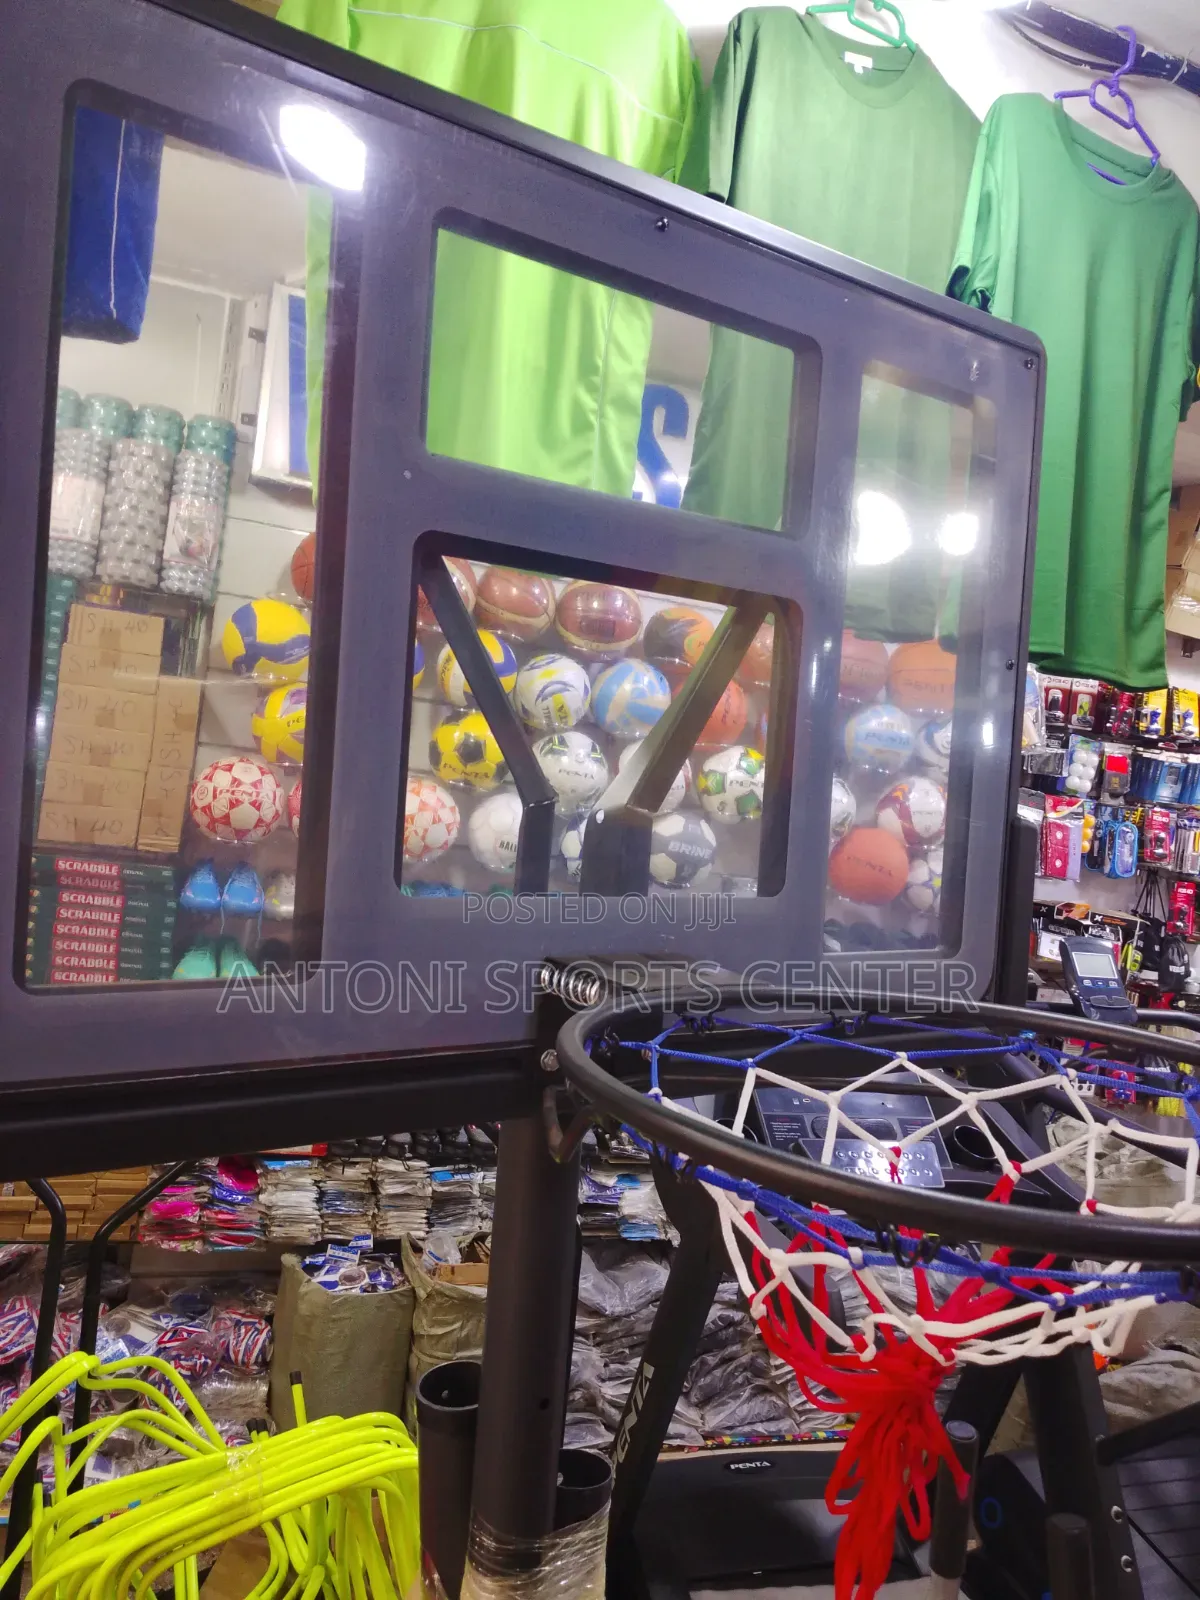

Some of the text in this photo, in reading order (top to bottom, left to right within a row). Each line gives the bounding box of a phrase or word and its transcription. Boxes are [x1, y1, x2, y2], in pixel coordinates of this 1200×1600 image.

[668, 840, 713, 859] BRINE
[57, 859, 119, 875] SCRABBLE
[62, 892, 123, 907] SCRABBLE
[59, 908, 121, 924] SCRABBLE
[56, 924, 118, 938] SCRABBLE
[54, 940, 117, 954] SCRABBLE
[55, 955, 116, 970] SCRABBLE
[53, 971, 116, 984] SCRABBLE
[730, 1460, 772, 1470] PENTA
